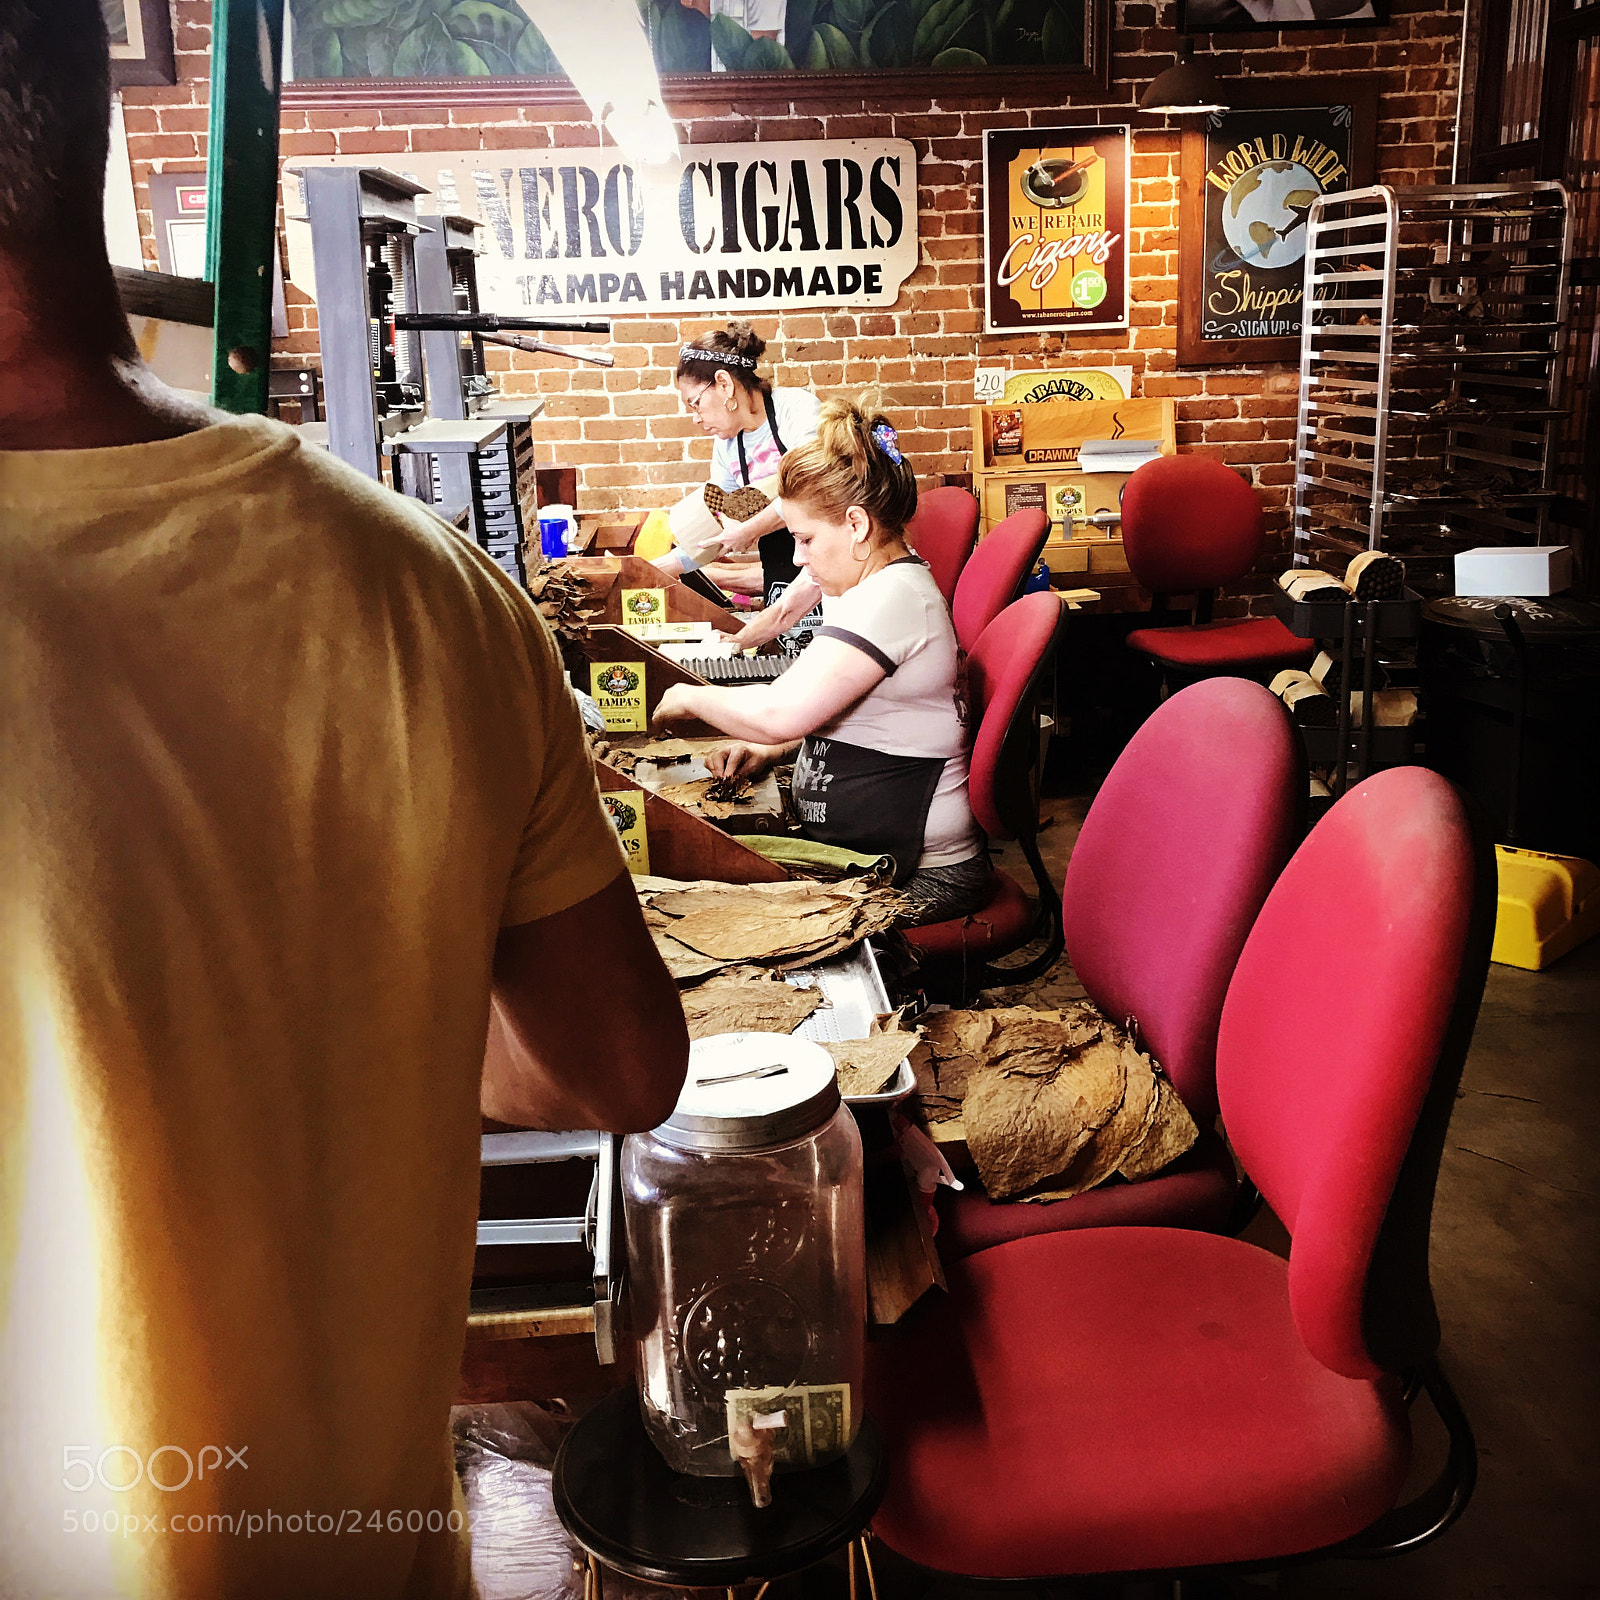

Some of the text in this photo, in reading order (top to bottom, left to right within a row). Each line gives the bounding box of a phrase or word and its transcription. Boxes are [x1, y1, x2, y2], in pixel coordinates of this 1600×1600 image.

[1206, 133, 1348, 193] WORLD WIDE
[679, 155, 902, 255] CIGARS
[1011, 214, 1103, 230] WE REPAIR
[997, 230, 1121, 290] Cigars
[514, 263, 883, 306] TAMPA HANDMADE
[1021, 309, 1094, 319] www.tabanerocigars.com
[1238, 320, 1290, 337] SIGN UP!
[1020, 379, 1094, 404] ABANER
[1028, 448, 1080, 462] DRAWMA
[628, 617, 661, 625] TAMPA'S
[597, 698, 641, 707] TAMPA'S
[813, 741, 831, 757] MY
